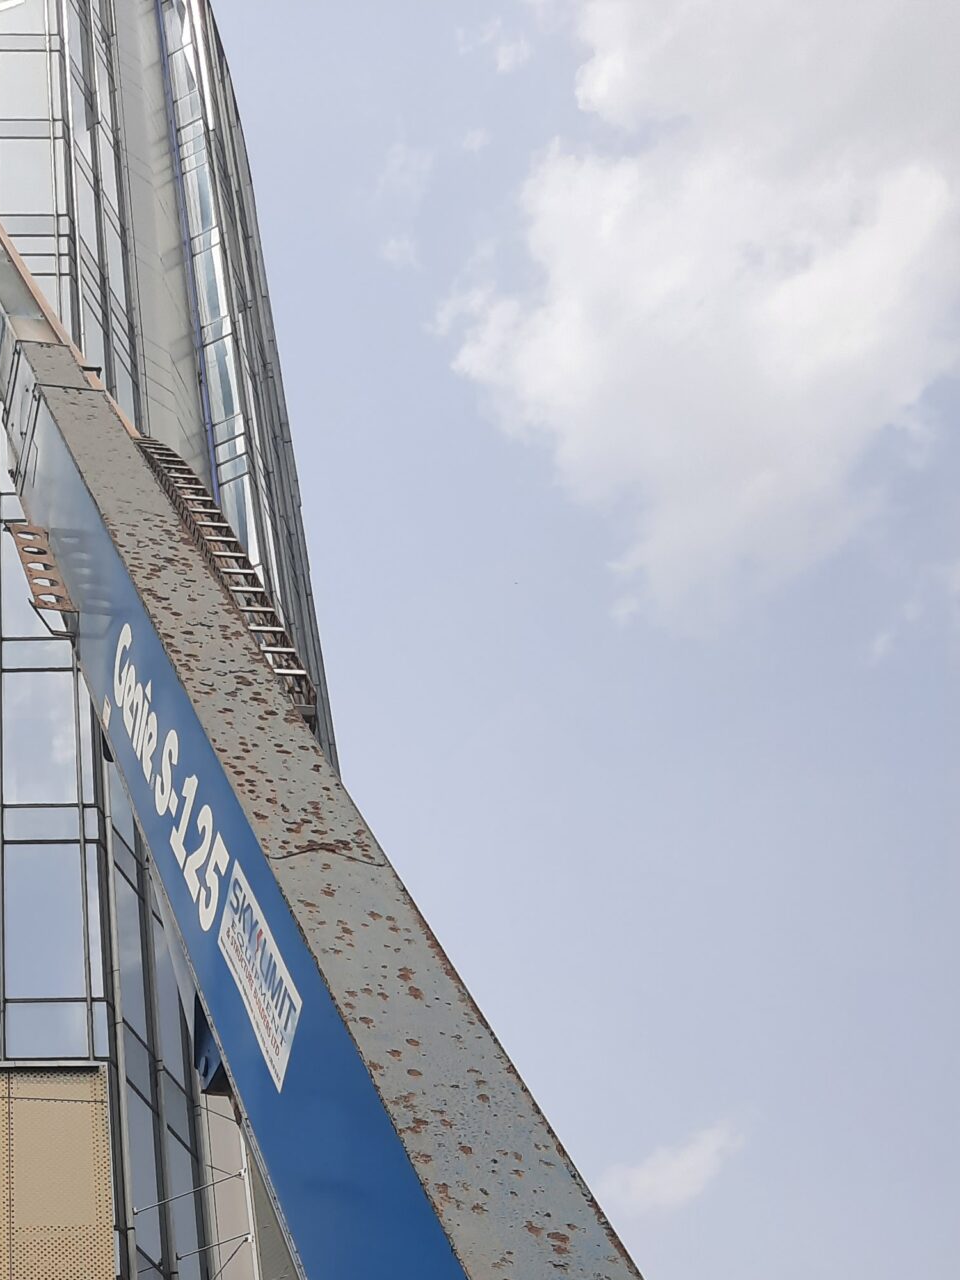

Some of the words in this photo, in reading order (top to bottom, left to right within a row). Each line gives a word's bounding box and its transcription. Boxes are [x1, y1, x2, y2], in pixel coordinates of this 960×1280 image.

[114, 623, 158, 784] Genie
[155, 729, 230, 932] S-125
[230, 877, 259, 945] SKY
[230, 936, 254, 993] STRUCTURE
[253, 986, 272, 1039] BUILDERS
[231, 917, 286, 1049] EQUIPMENT
